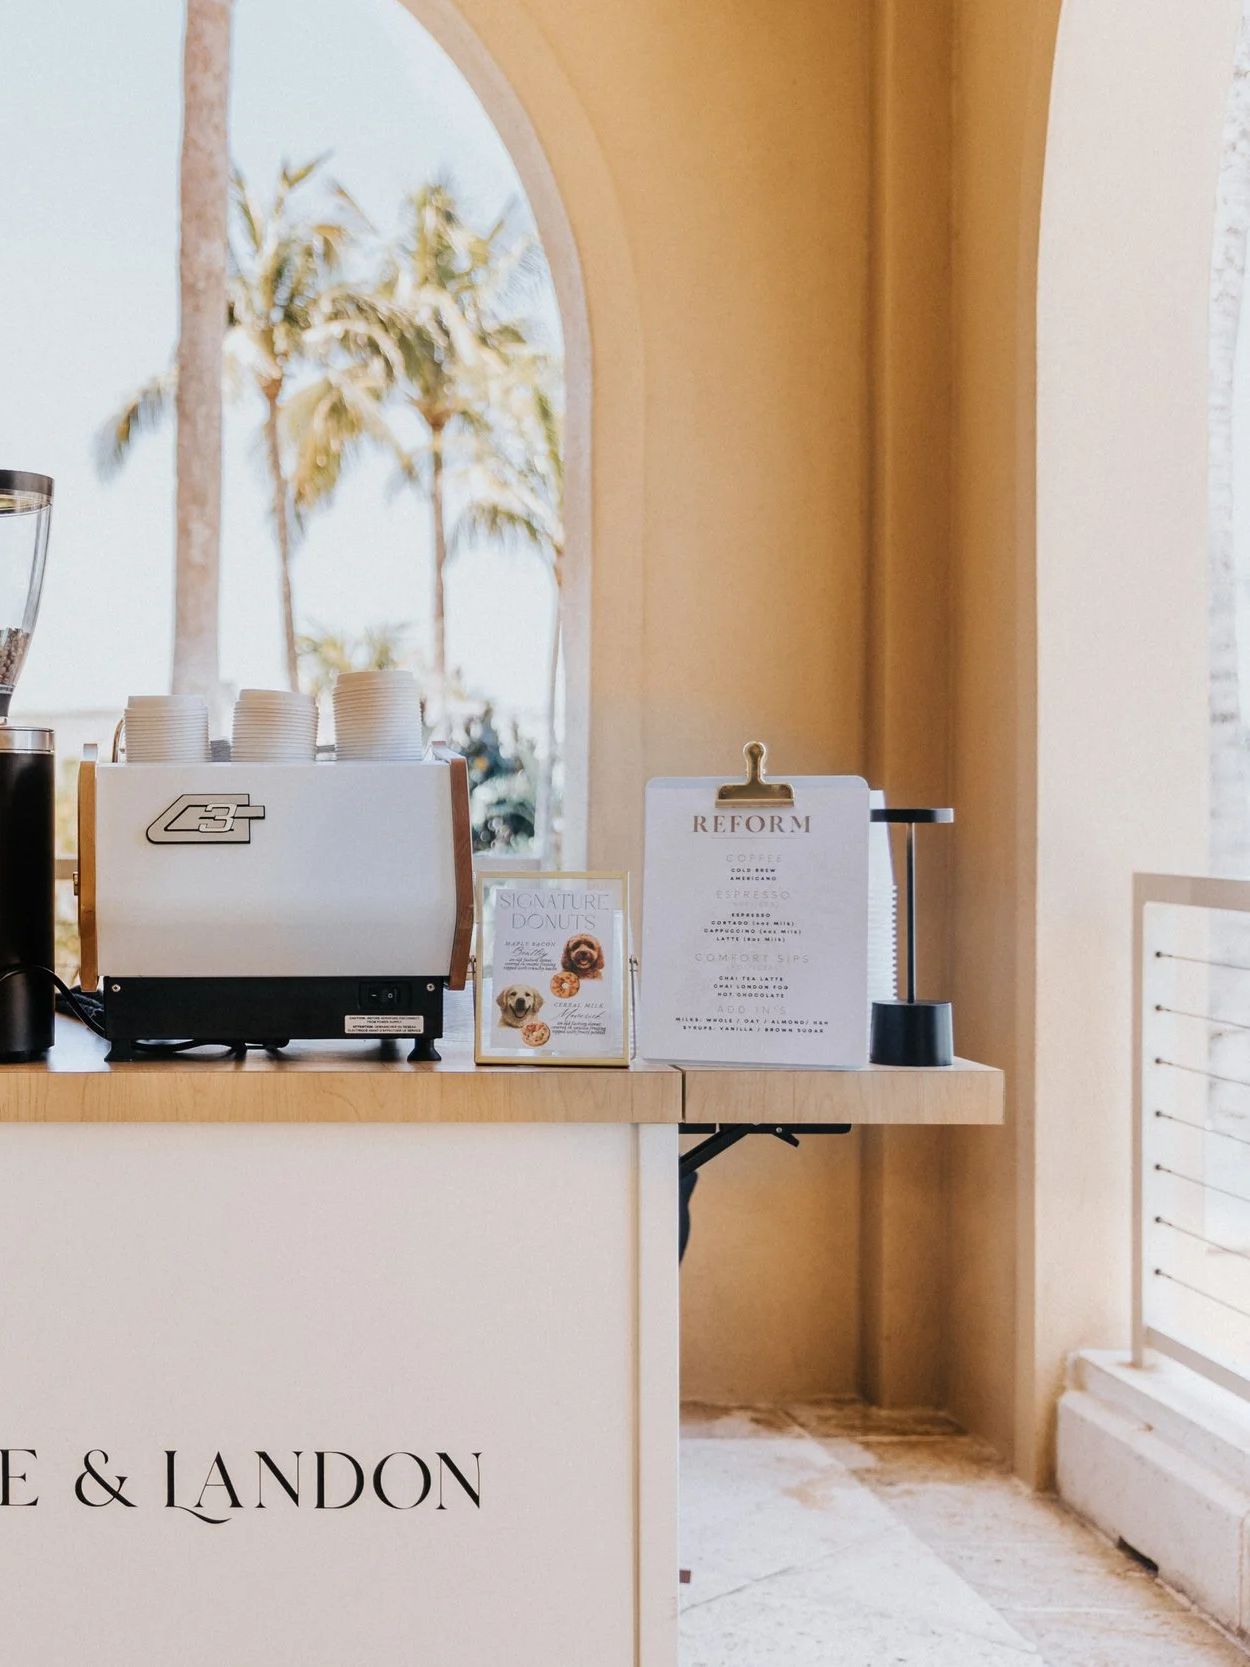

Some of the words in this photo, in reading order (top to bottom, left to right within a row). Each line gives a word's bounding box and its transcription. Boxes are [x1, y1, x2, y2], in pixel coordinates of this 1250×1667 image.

[692, 815, 811, 833] REFORM
[726, 854, 782, 863] COFFEE
[500, 892, 609, 911] SIGNATURE
[716, 890, 790, 900] ESPRESSO
[512, 913, 596, 930] DONUTS
[694, 953, 769, 962] COMFORT
[777, 954, 810, 964] SIPS
[717, 1005, 746, 1014] ADD
[74, 1449, 137, 1508] &
[164, 1450, 483, 1525] LANDON
